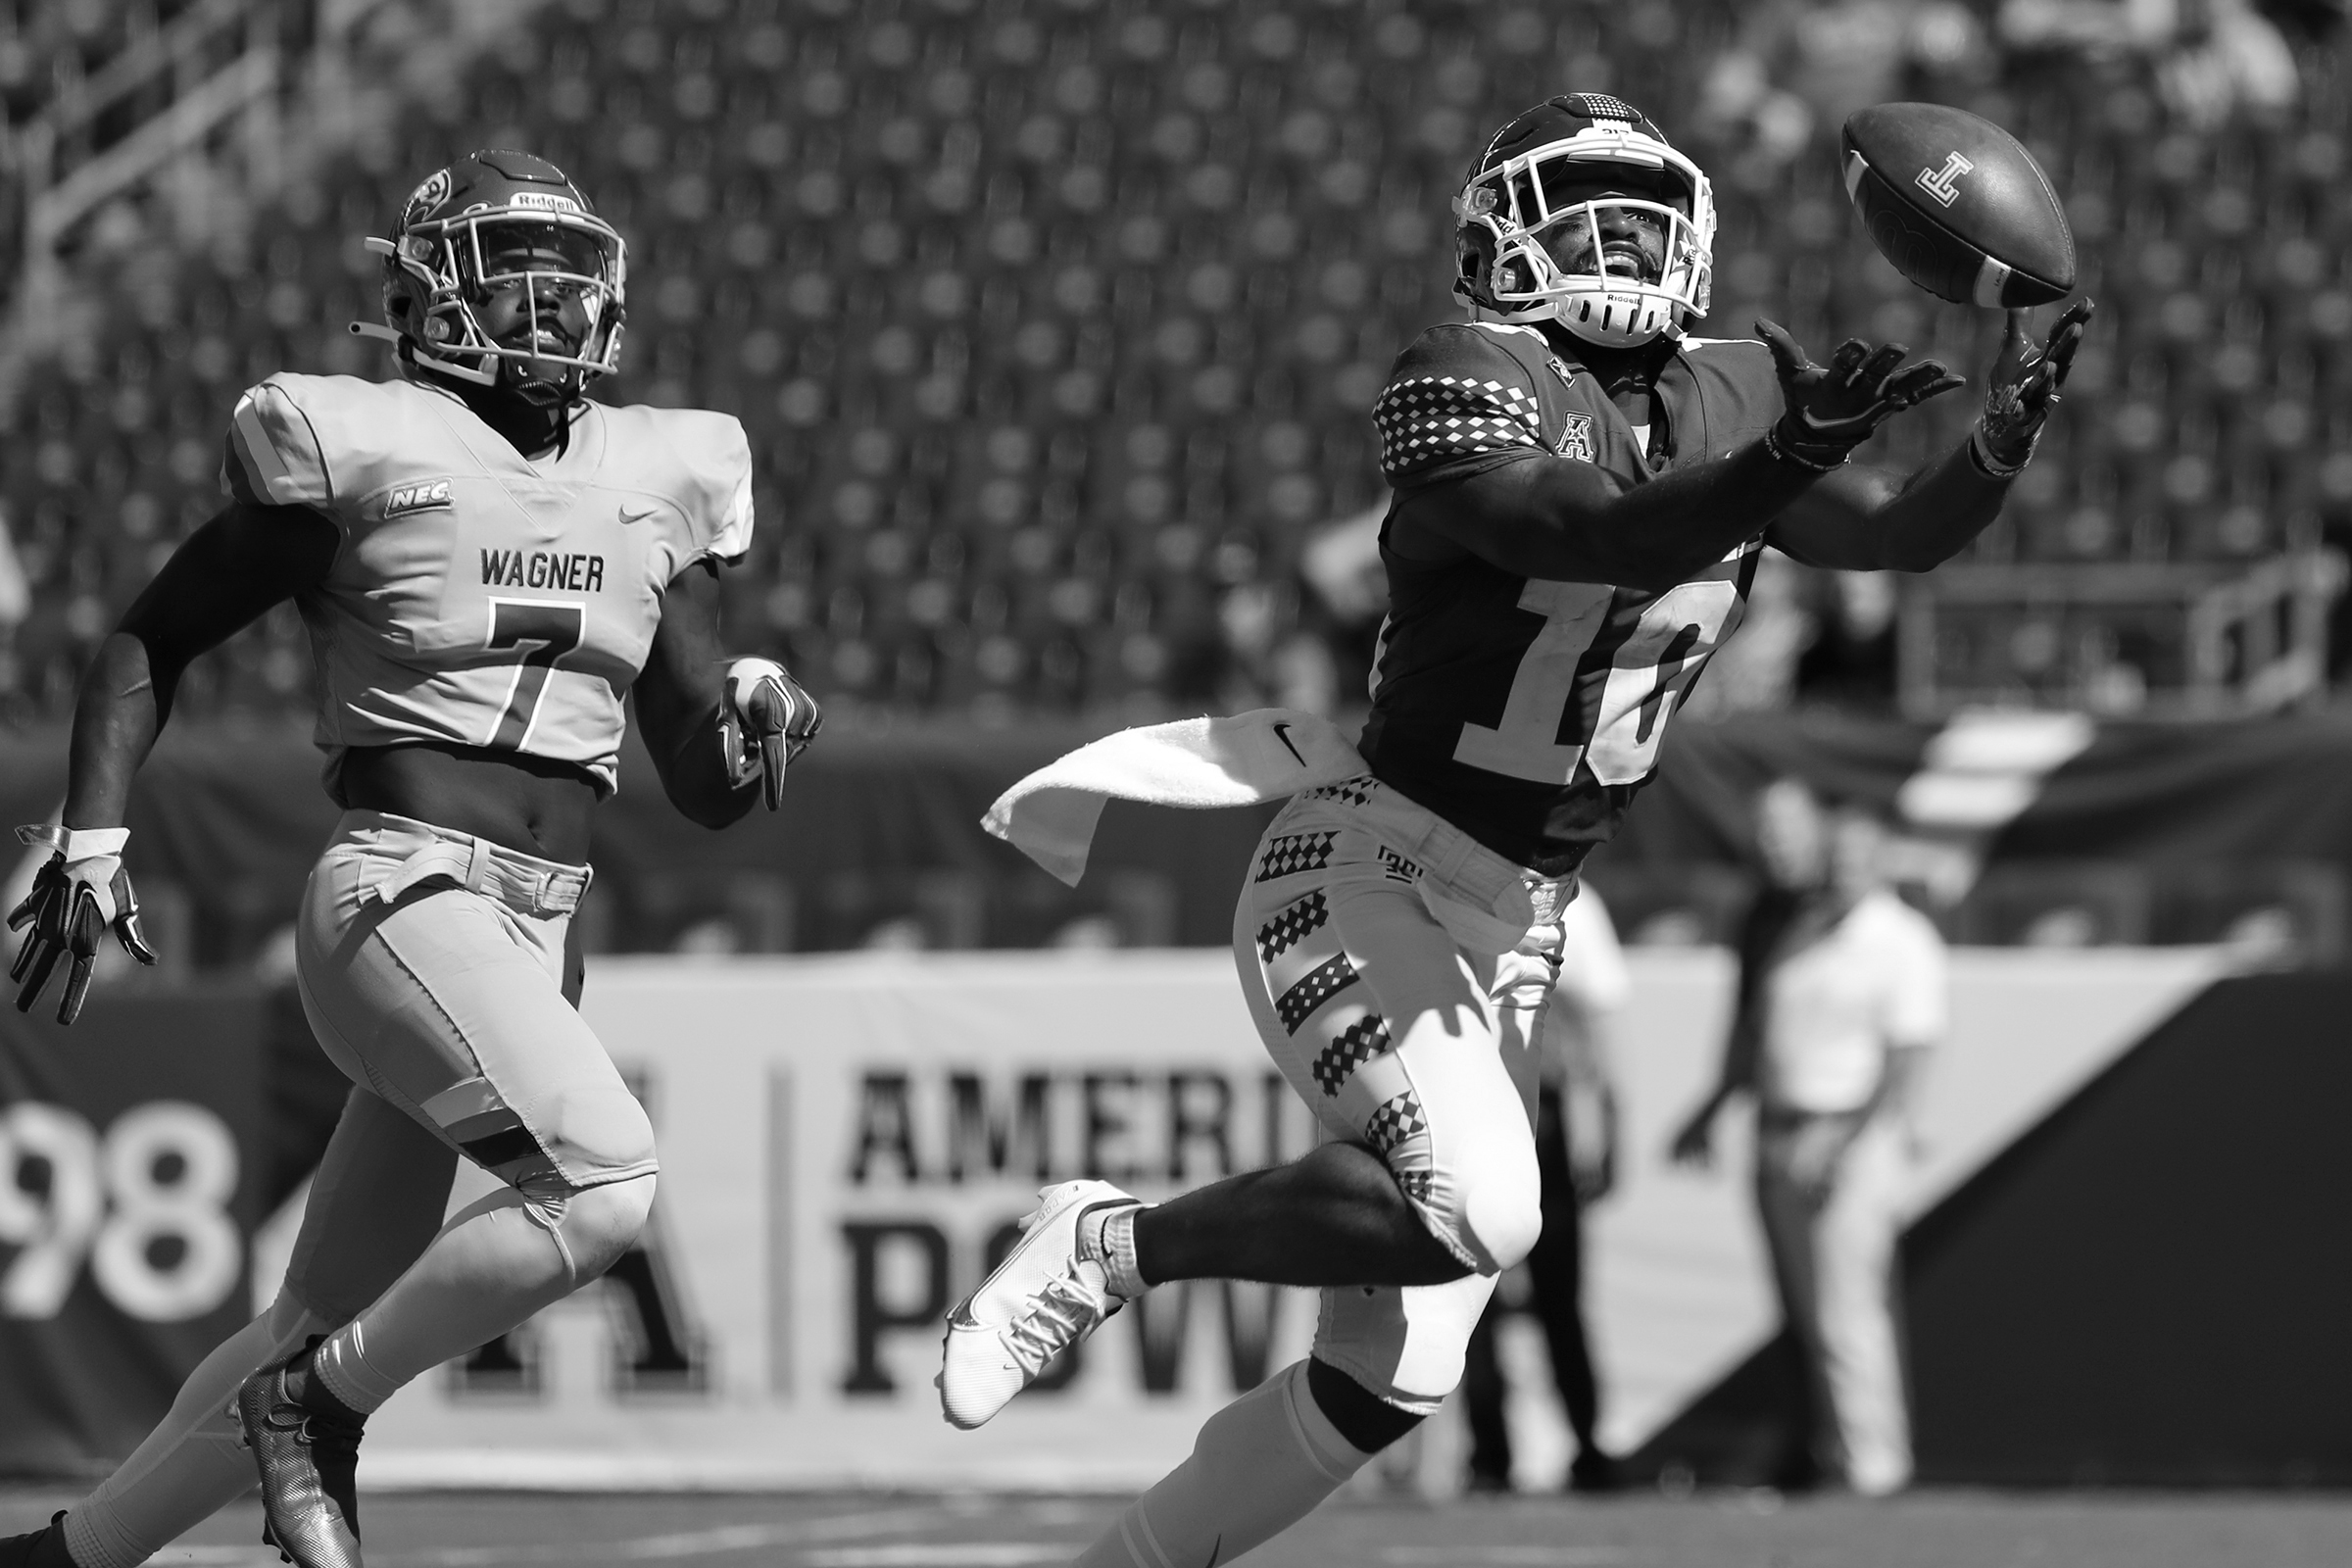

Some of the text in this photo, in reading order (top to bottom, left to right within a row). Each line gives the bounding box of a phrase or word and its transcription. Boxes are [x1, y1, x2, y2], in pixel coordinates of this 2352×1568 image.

[518, 193, 576, 209] Riddell
[1607, 294, 1642, 305] Riddell
[479, 548, 604, 592] WAGNER
[481, 596, 586, 752] 7
[0, 1100, 242, 1321] 98
